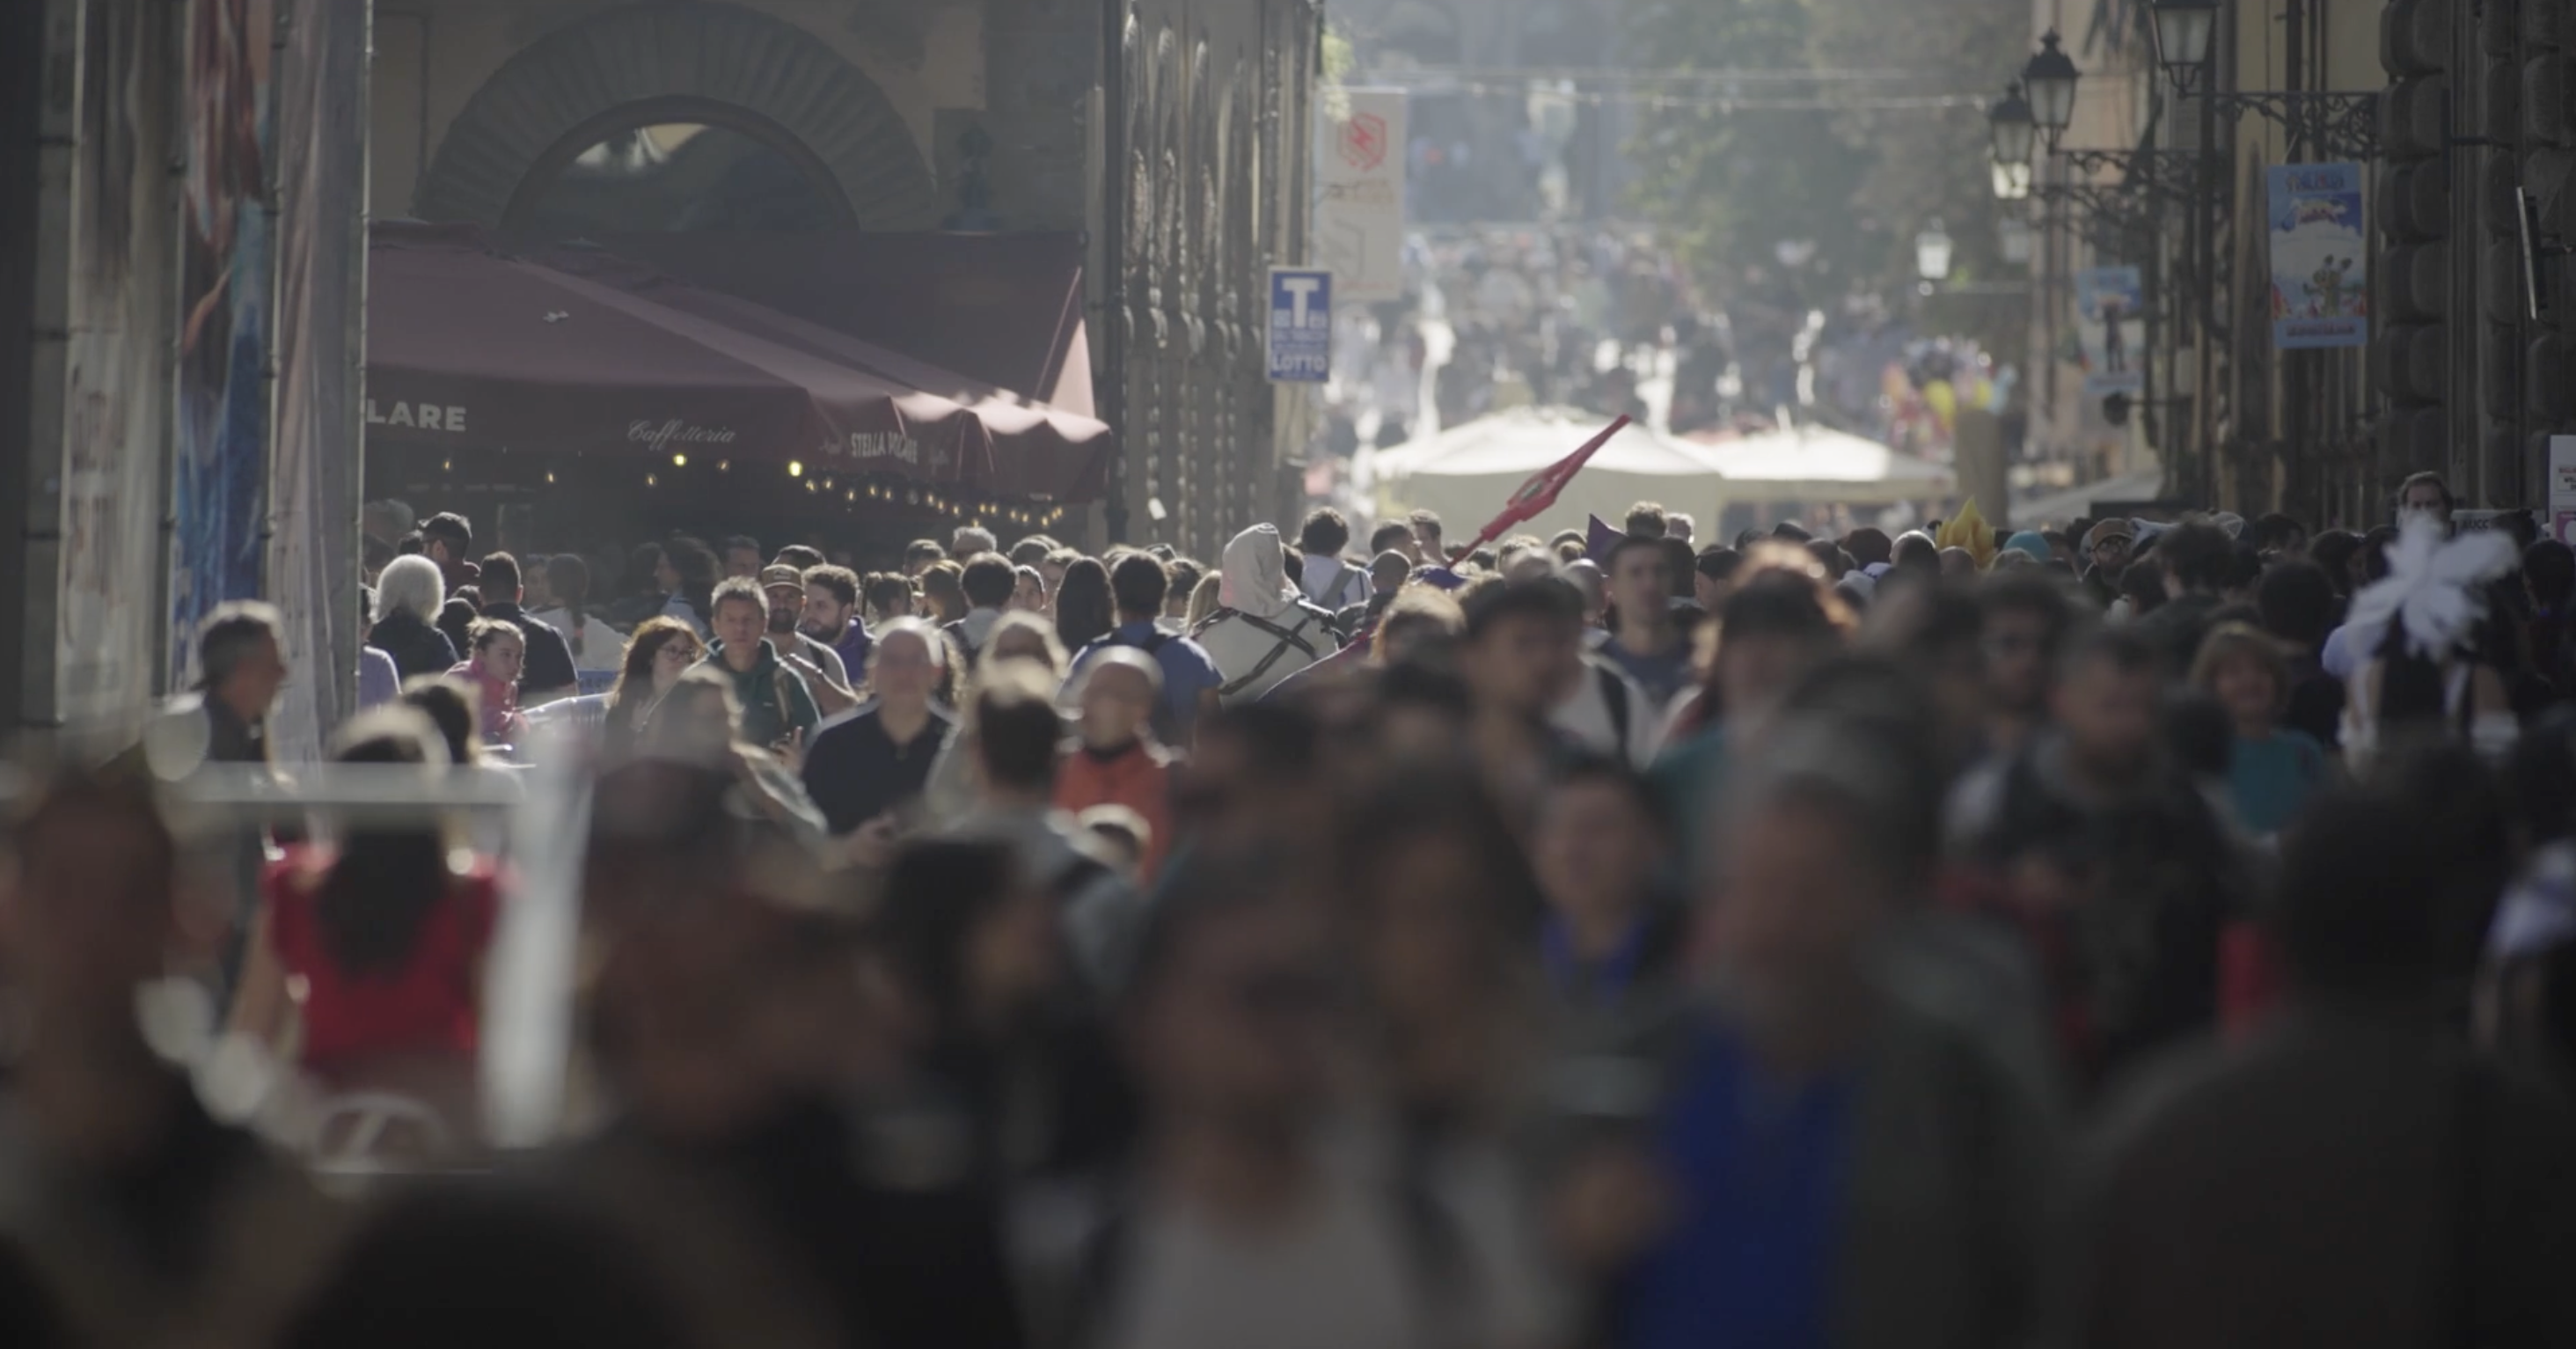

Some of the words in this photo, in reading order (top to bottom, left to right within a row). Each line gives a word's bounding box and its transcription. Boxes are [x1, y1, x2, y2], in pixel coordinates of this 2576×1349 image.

[1282, 277, 1320, 327] T
[1272, 354, 1327, 371] LOTTO
[627, 419, 736, 451] Caffetteria
[851, 431, 886, 458] STELLA
